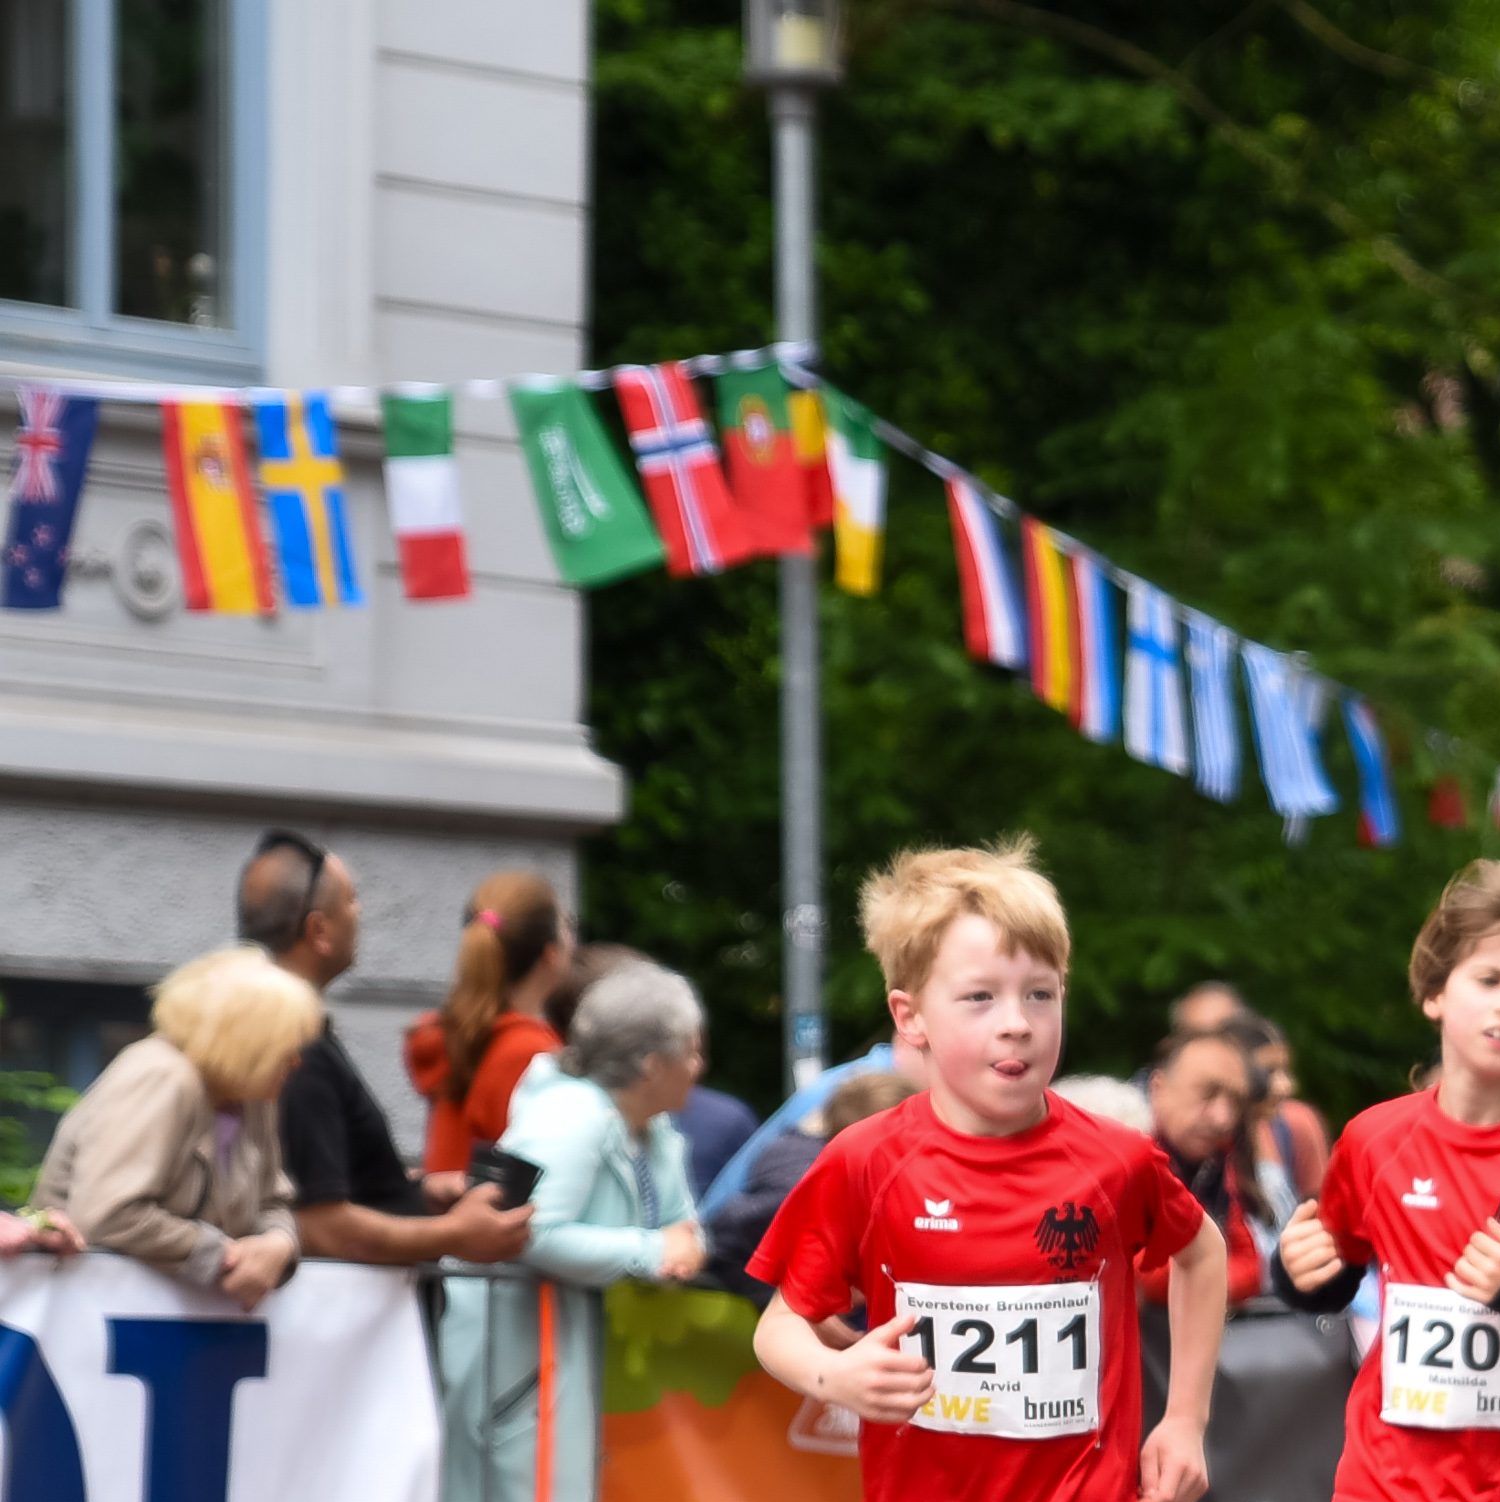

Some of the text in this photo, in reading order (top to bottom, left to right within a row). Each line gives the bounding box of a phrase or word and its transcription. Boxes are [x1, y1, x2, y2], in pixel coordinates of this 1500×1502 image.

[907, 1294, 1090, 1312] Everstener Brunnenlauf
[907, 1314, 1087, 1374] 1211
[979, 1380, 1021, 1392] Arvid
[1392, 1386, 1448, 1415] EWE
[921, 1394, 1085, 1423] EWE bruns
